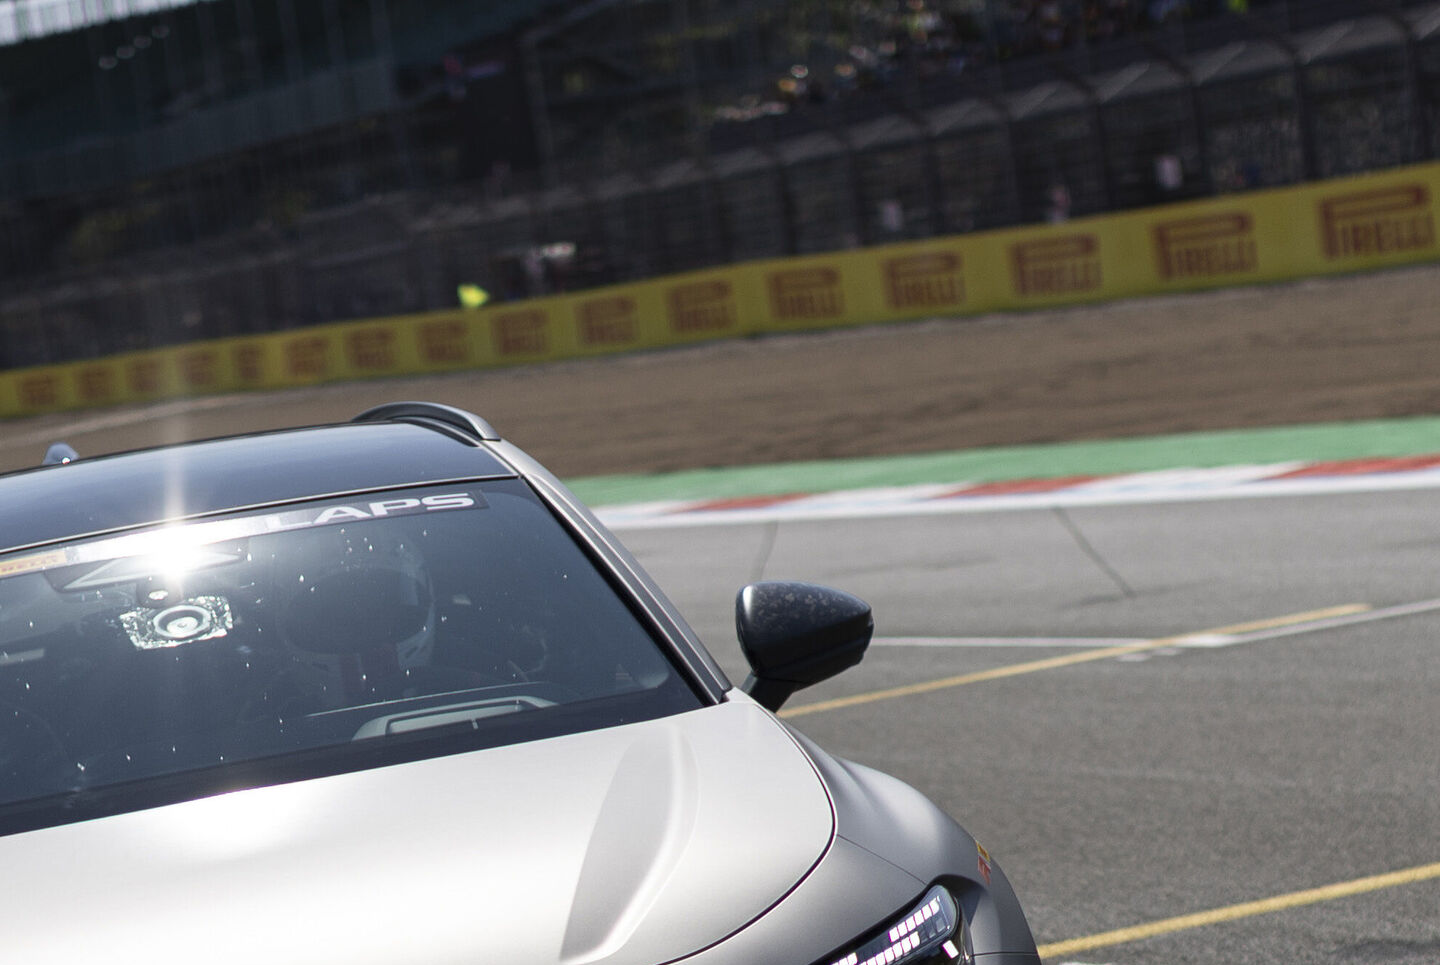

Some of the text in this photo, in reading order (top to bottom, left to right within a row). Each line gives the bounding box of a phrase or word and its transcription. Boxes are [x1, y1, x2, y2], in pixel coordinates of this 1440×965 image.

[1152, 212, 1258, 280] PIRELLI
[1319, 186, 1434, 259] PIRELLI
[1009, 234, 1103, 296] PIRELLI
[264, 493, 477, 530] LAPS
